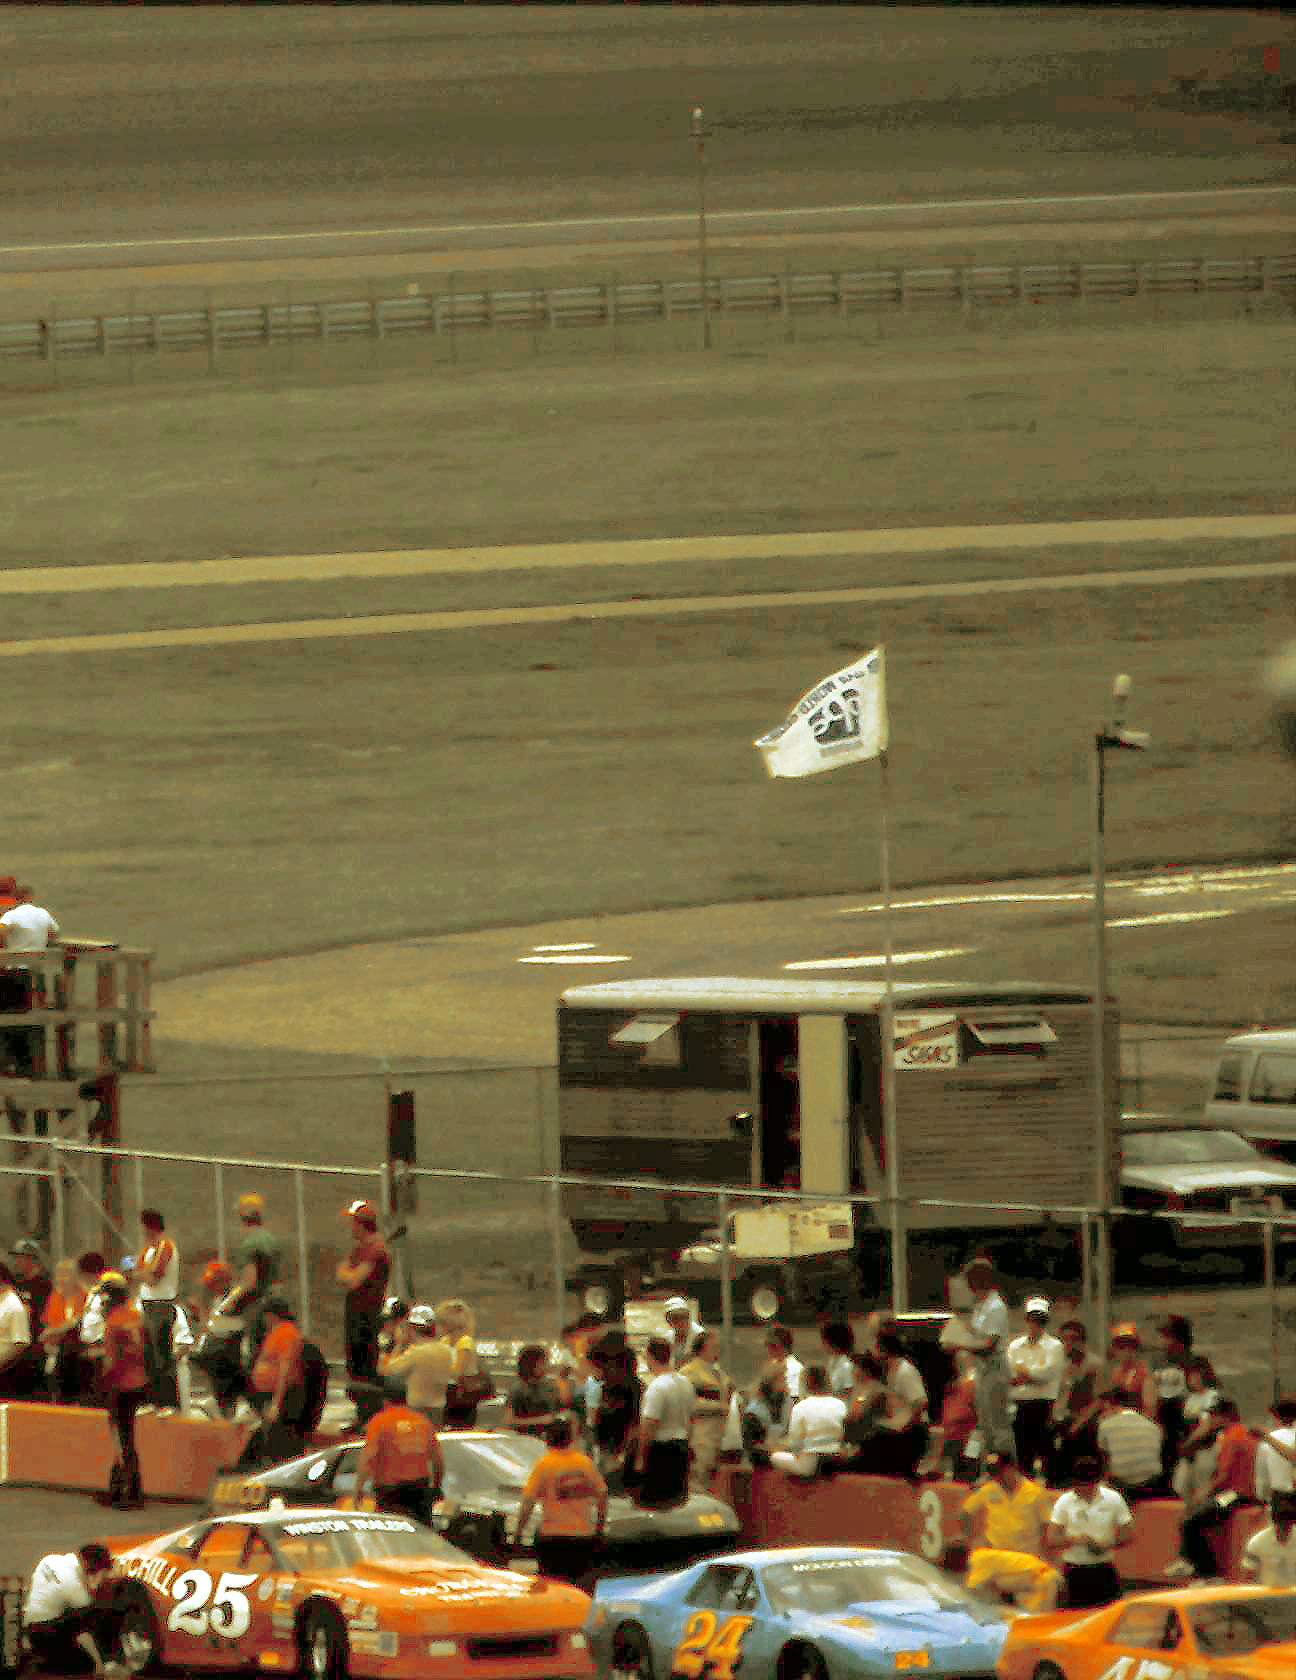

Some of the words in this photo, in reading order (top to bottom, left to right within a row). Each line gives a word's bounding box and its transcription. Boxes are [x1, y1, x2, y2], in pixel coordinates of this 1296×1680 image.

[919, 1489, 943, 1558] 3
[168, 1569, 259, 1639] 25
[672, 1608, 753, 1680] 24
